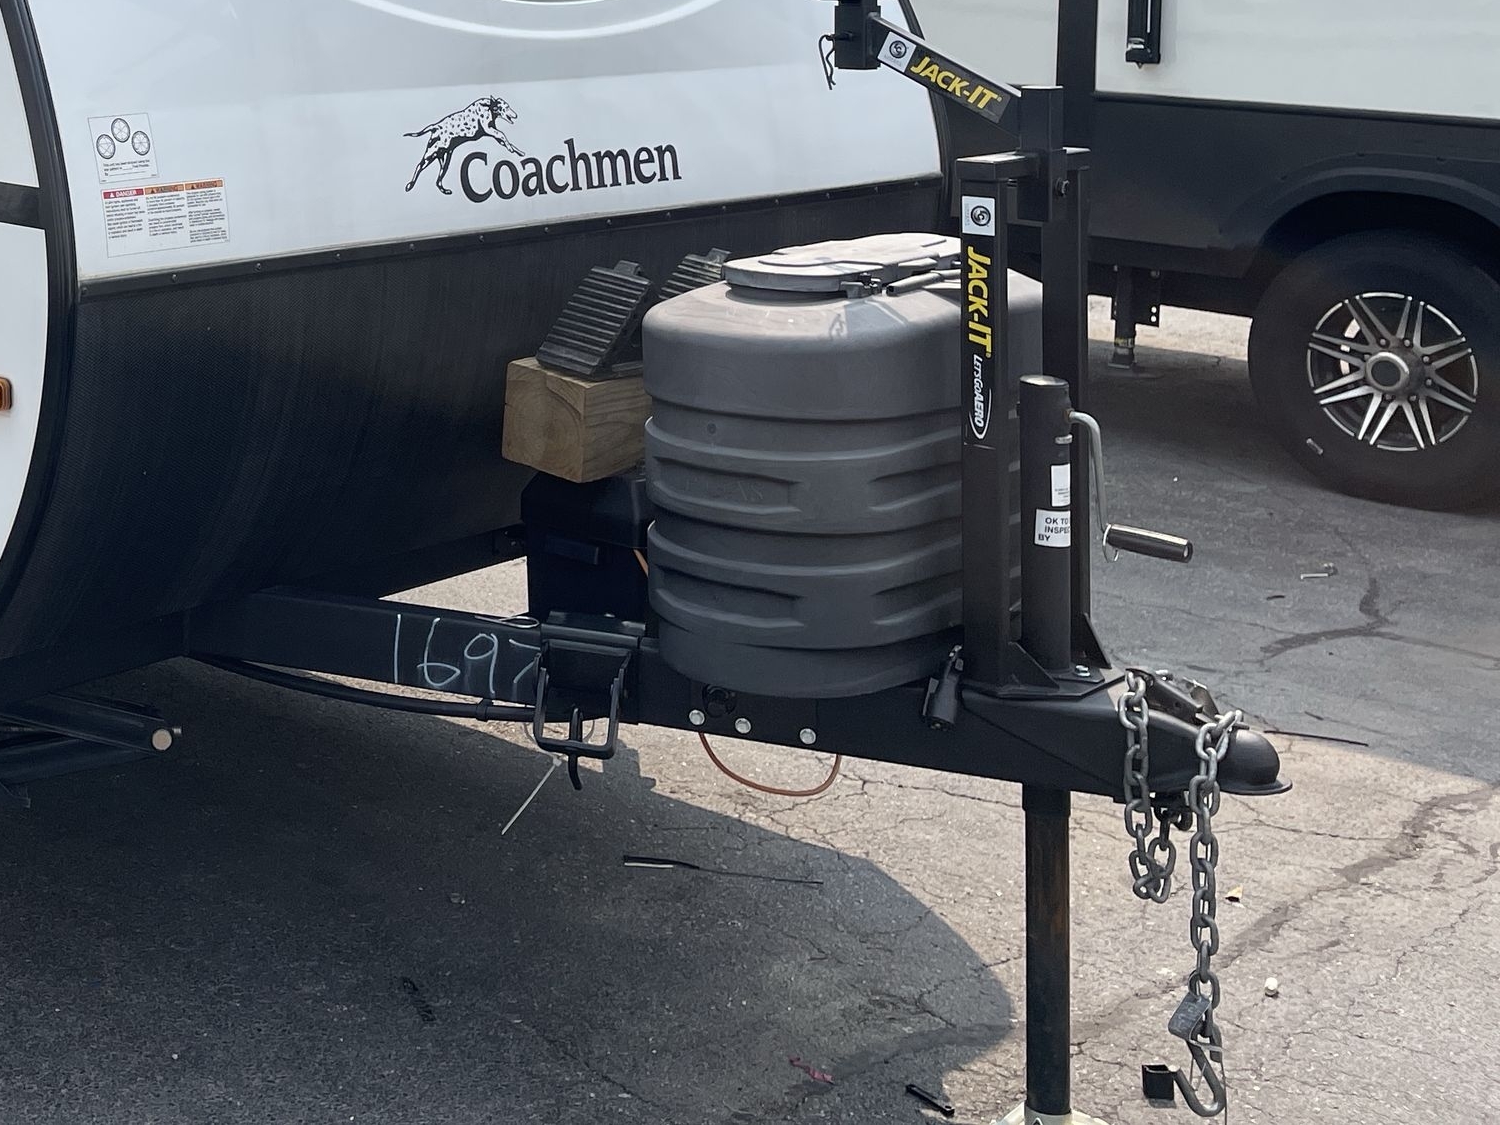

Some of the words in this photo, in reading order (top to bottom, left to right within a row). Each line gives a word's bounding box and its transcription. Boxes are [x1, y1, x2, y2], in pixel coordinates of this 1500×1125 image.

[459, 137, 683, 204] Coachmen
[967, 246, 993, 359] JACK-IT
[1038, 533, 1050, 542] BY
[1045, 517, 1059, 525] OK
